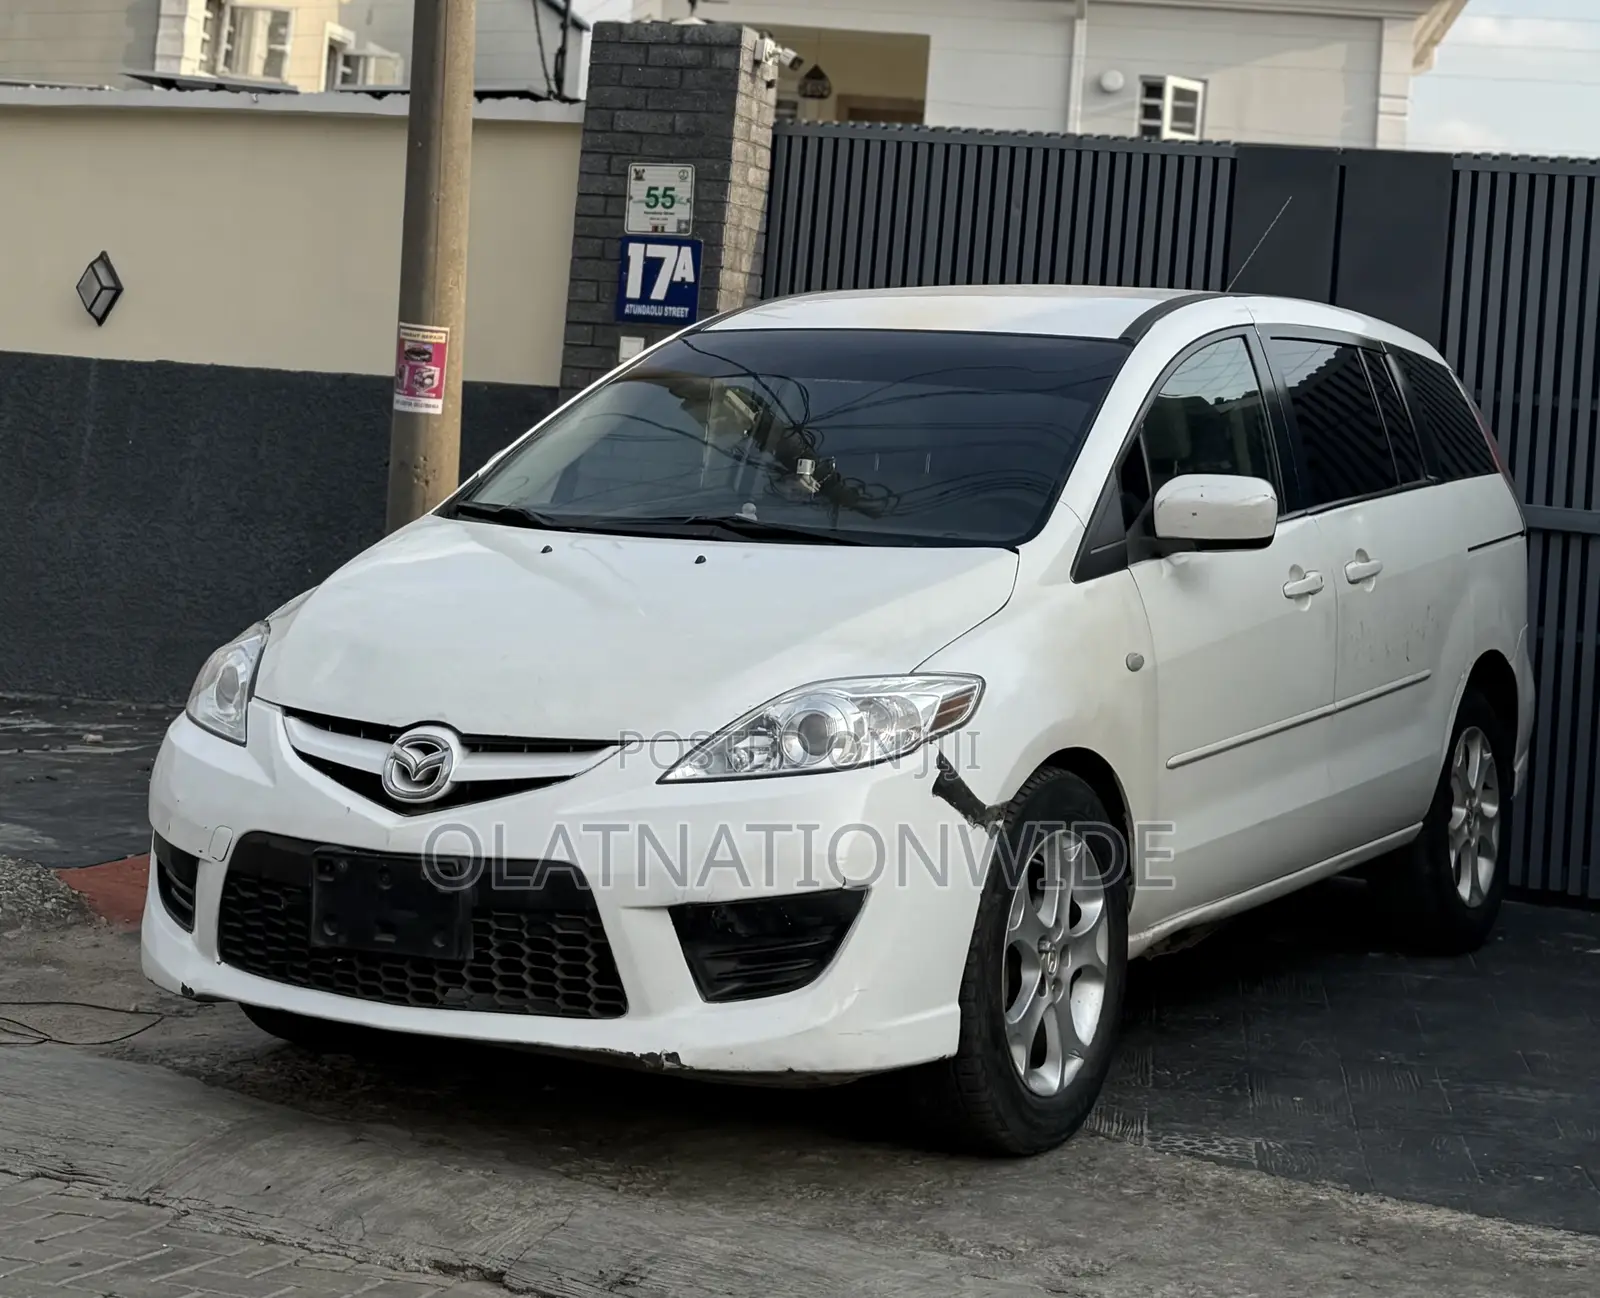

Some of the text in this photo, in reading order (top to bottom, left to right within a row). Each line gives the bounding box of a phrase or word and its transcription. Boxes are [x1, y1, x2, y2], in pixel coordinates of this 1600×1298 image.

[644, 185, 676, 210] 55
[625, 242, 696, 301] 17A
[664, 305, 690, 318] STREET
